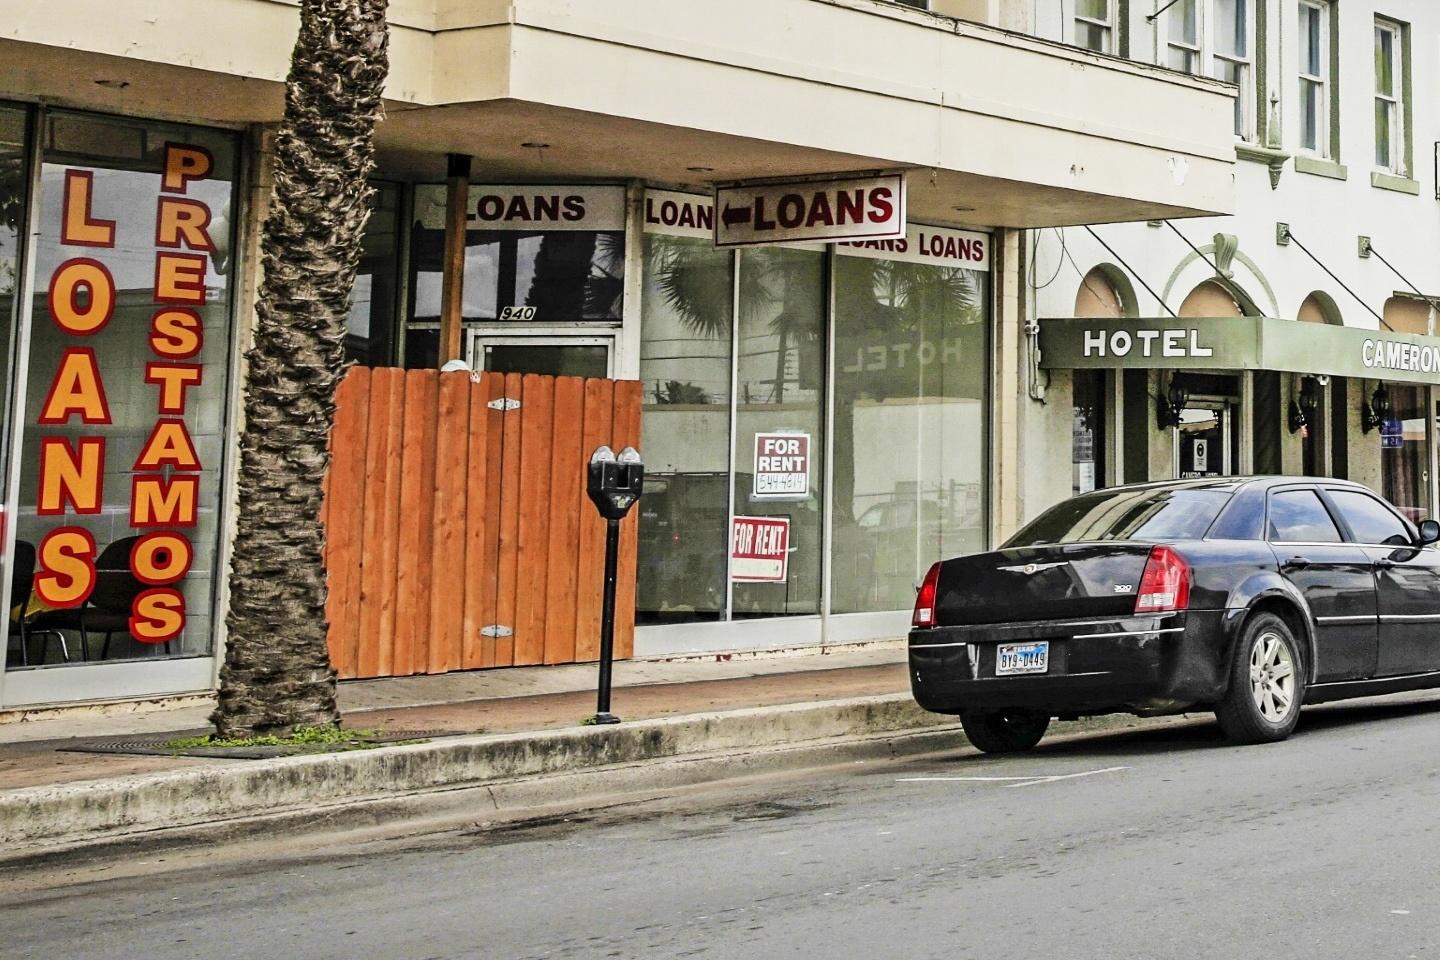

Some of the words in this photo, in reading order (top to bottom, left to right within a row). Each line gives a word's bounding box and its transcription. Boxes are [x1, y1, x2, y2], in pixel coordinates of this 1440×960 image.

[754, 187, 893, 231] LOANS
[919, 233, 984, 261] LOANS
[502, 306, 534, 320] 940
[1084, 330, 1213, 357] HOTEL
[34, 168, 117, 608] LOANS
[129, 141, 219, 644] PRESTAMOS
[764, 440, 799, 455] FOR
[758, 457, 805, 471] RENT
[733, 523, 754, 554] FOR
[754, 525, 784, 556] RENT
